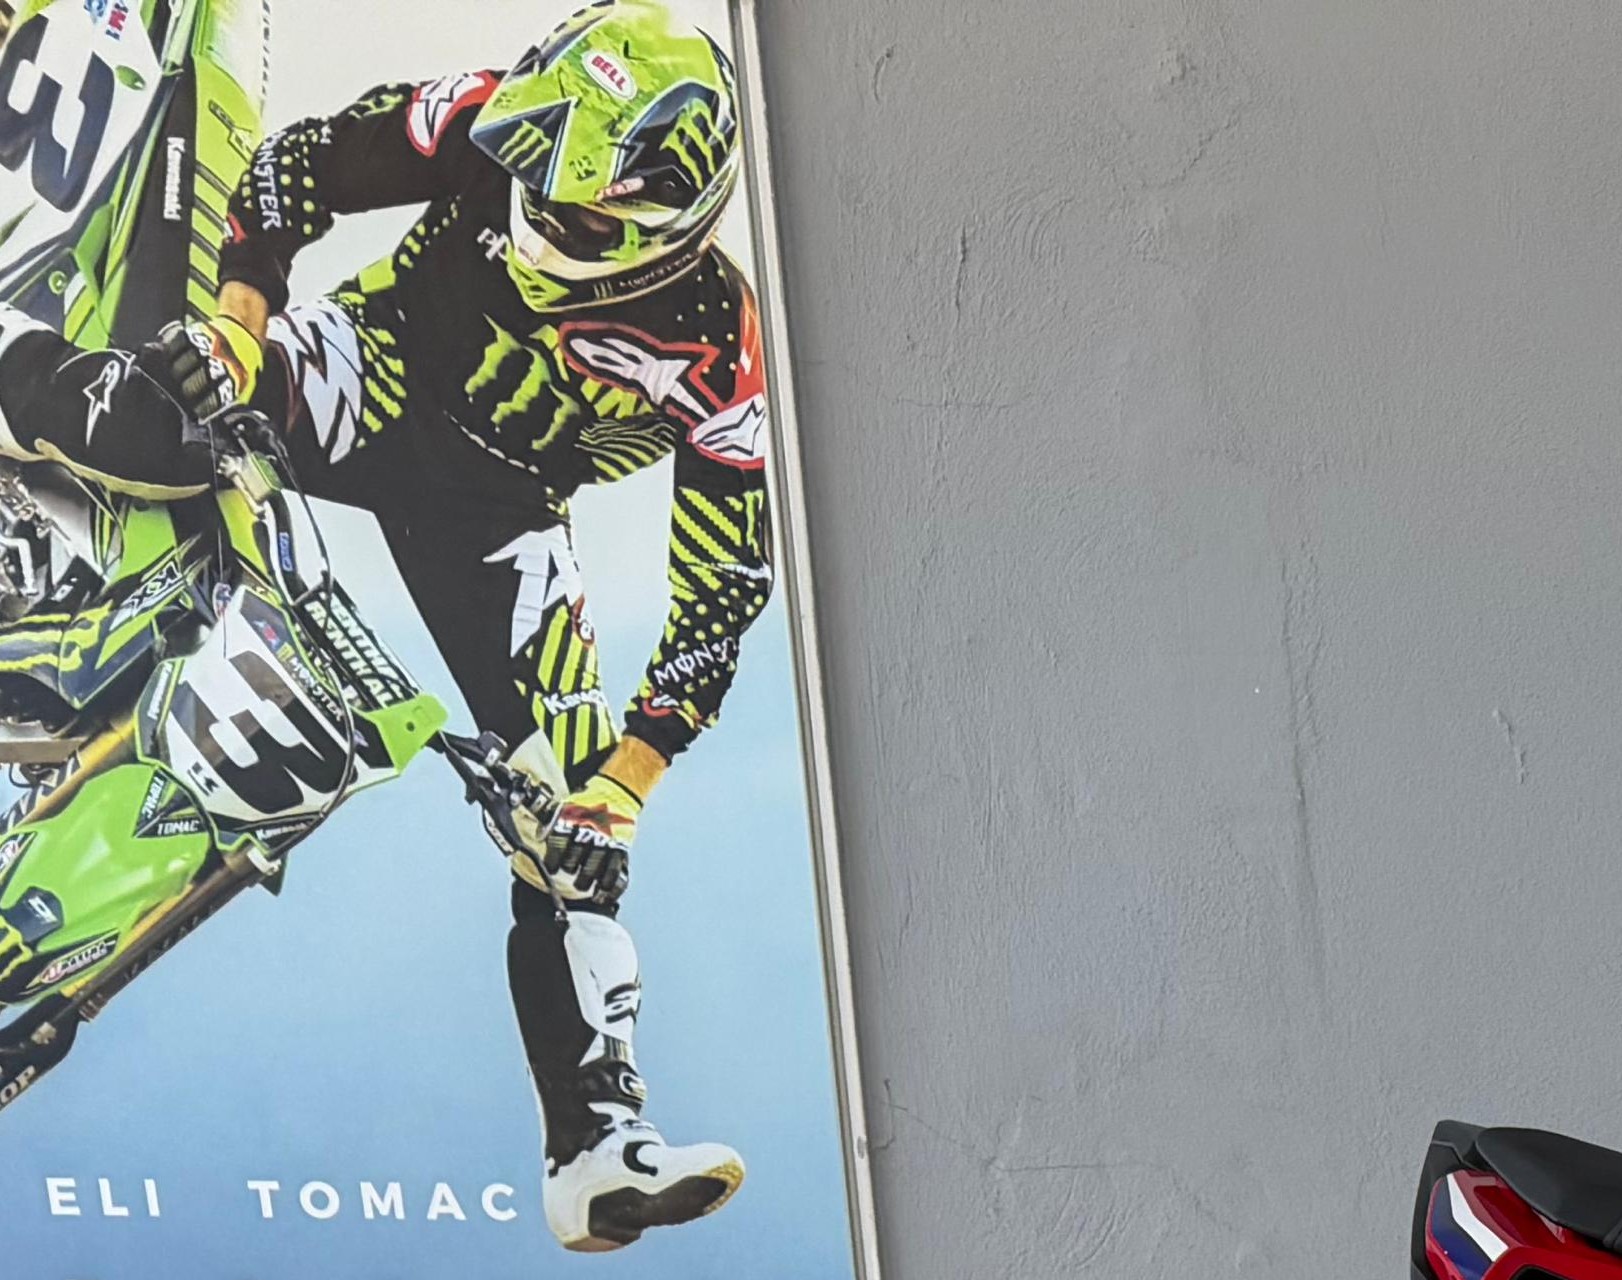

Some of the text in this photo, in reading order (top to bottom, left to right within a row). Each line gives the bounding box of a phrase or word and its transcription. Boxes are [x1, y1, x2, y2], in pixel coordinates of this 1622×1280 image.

[590, 54, 628, 92] BELL
[253, 131, 285, 231] ONSTER
[304, 600, 394, 709] RENTHAL
[142, 776, 165, 819] TOMAC
[157, 820, 200, 835] TOMAC
[45, 1176, 519, 1222] ELI TOMAC
